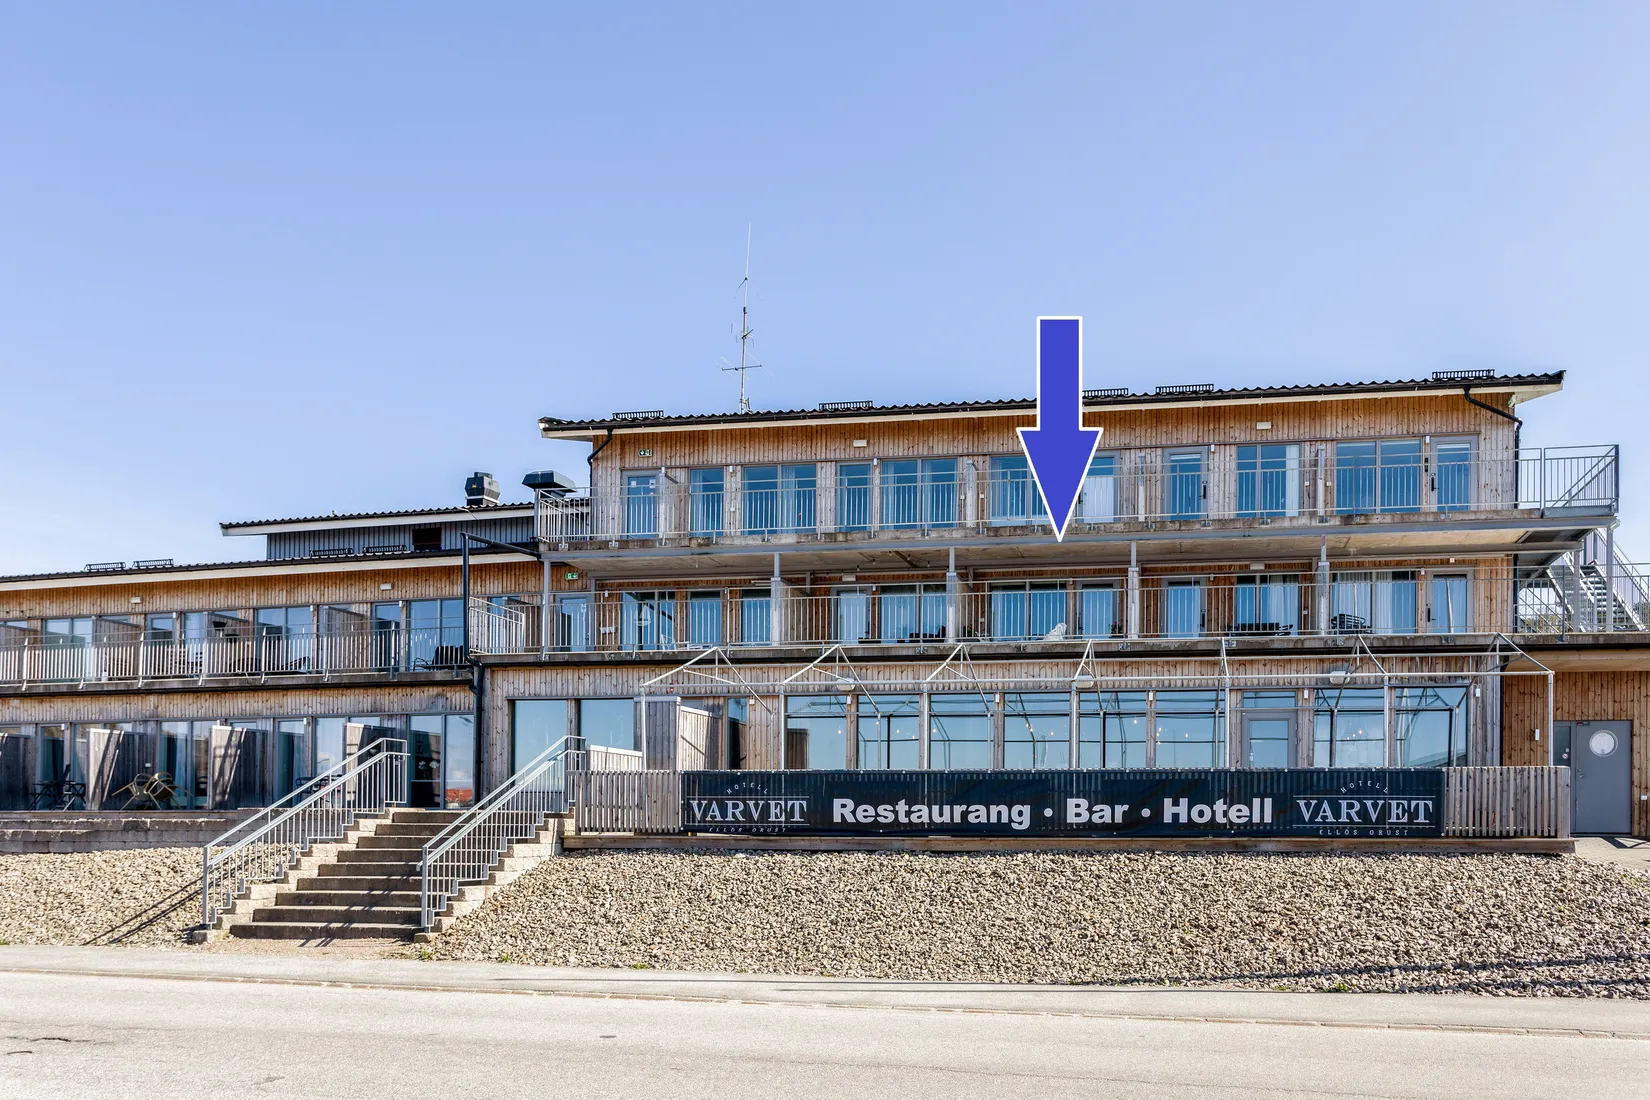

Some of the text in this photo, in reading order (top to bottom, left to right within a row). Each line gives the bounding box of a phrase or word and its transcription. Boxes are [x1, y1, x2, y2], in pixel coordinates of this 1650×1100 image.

[726, 782, 769, 795] HOTELL
[1340, 780, 1389, 794] HOTELL
[689, 800, 808, 822] VARVET
[832, 797, 1273, 830] Restaurang Bar Hotell
[1296, 799, 1433, 823] VARVET
